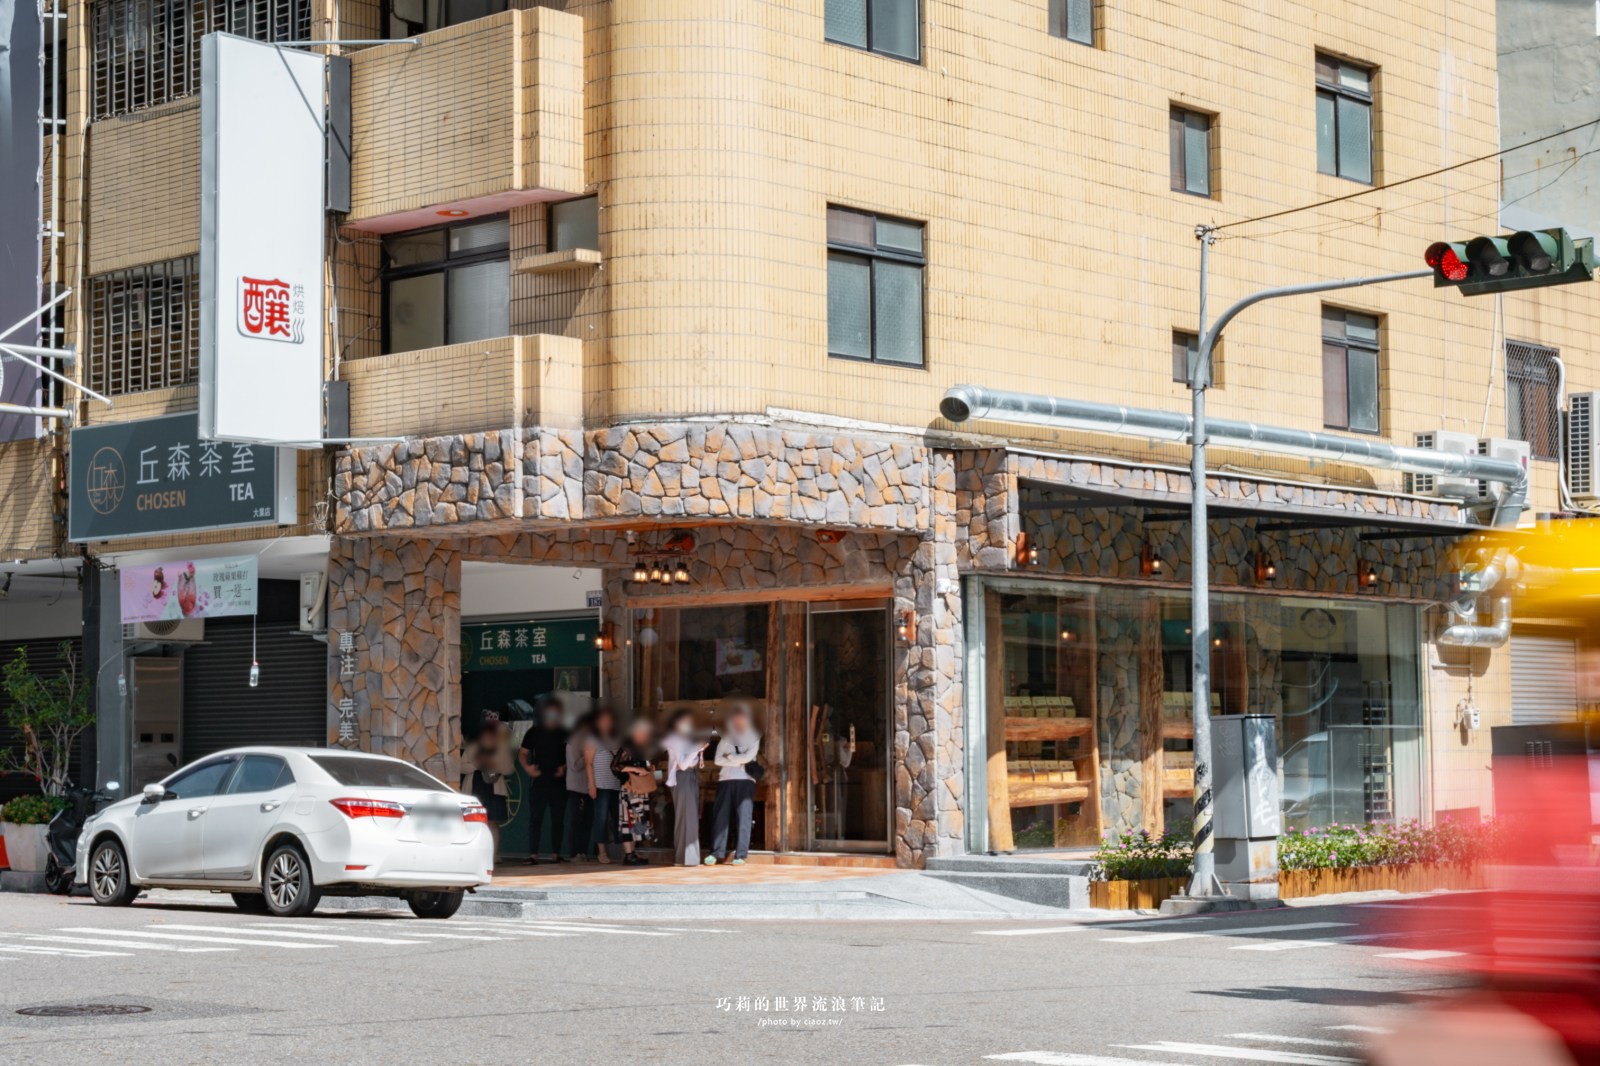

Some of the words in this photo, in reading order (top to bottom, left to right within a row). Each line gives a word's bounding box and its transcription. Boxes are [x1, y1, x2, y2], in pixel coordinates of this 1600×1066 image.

[136, 440, 255, 485] 丘森茶室
[136, 489, 187, 512] CHOSEN
[229, 482, 254, 502] TEA
[339, 631, 354, 676] 專注
[480, 627, 547, 651] 丘森茶室
[480, 656, 509, 666] CHOSEN
[531, 654, 547, 664] TEA
[339, 697, 353, 742] 完美
